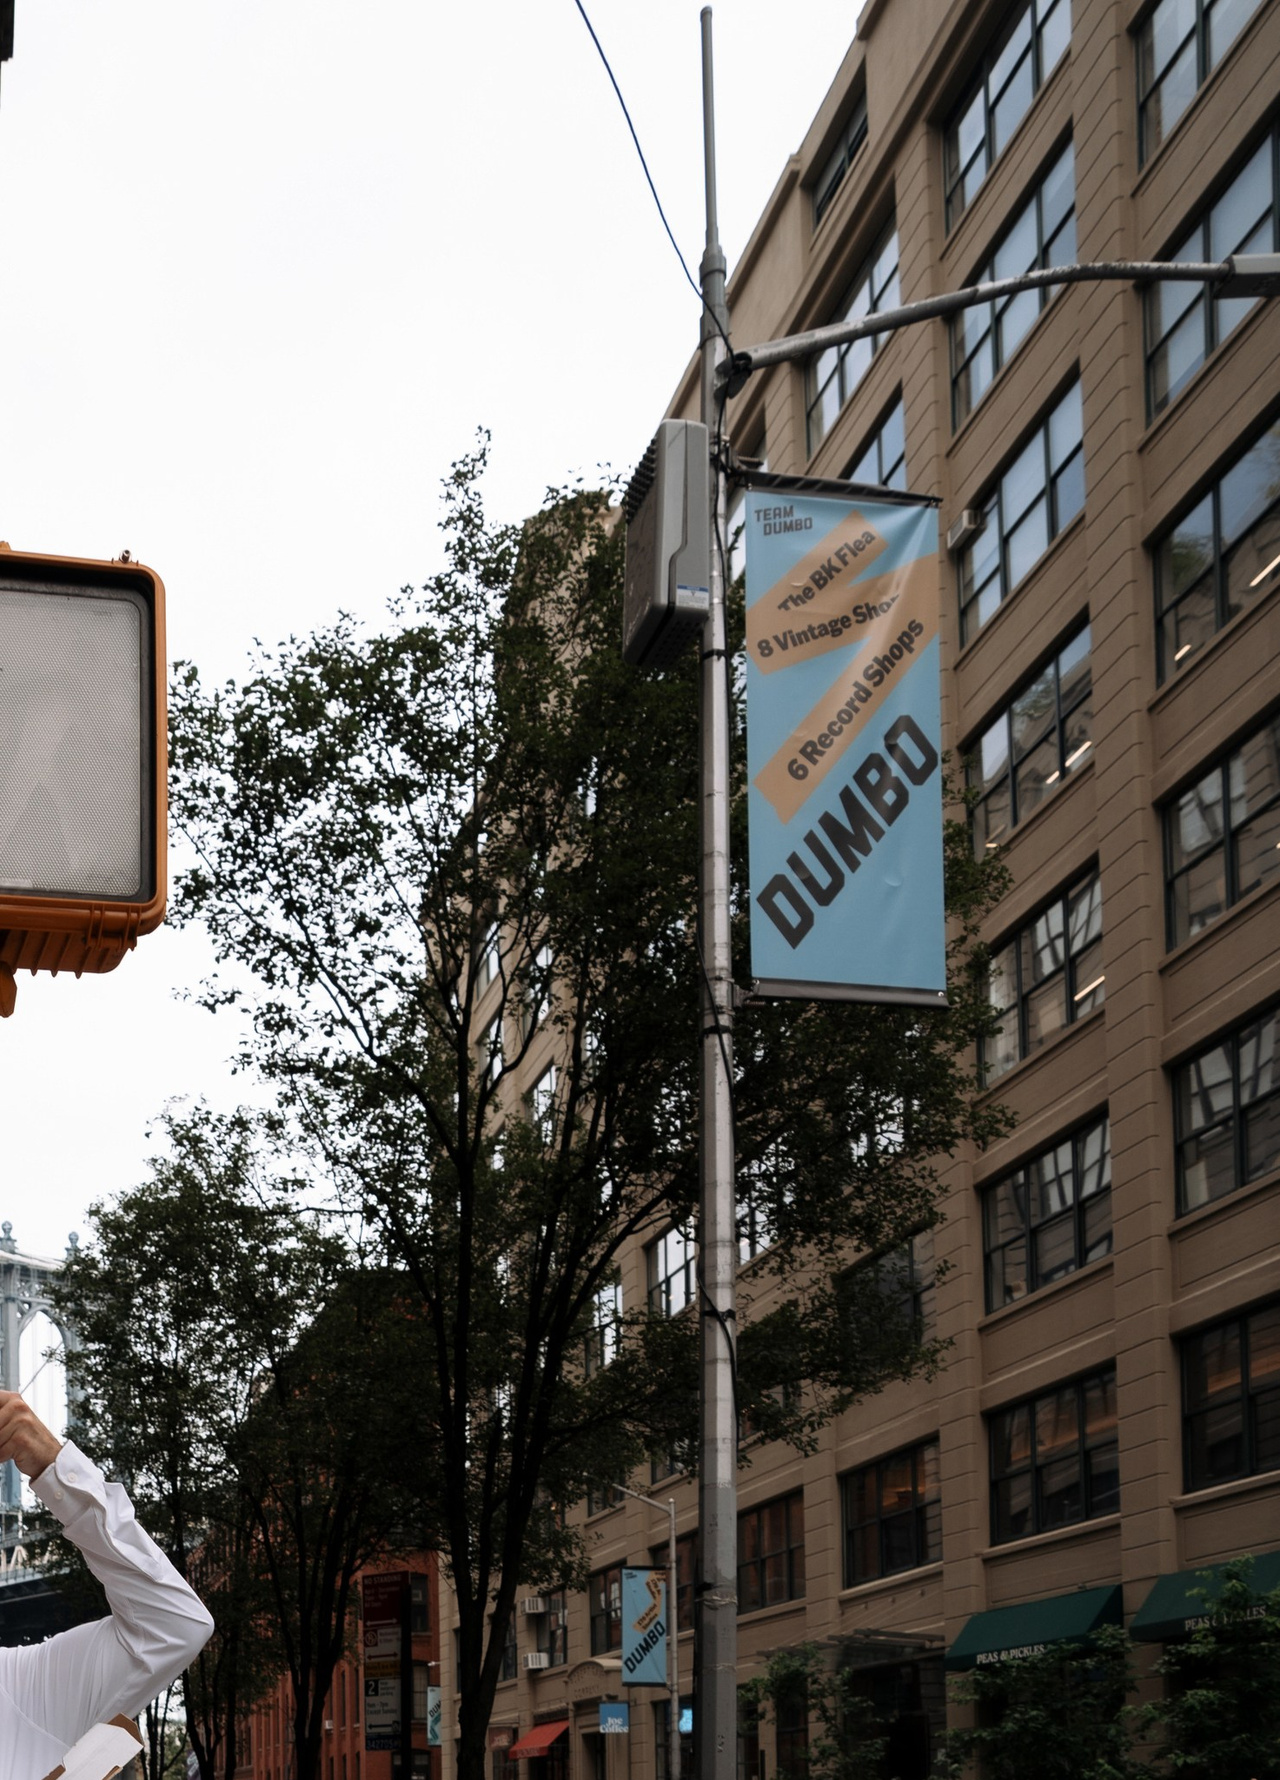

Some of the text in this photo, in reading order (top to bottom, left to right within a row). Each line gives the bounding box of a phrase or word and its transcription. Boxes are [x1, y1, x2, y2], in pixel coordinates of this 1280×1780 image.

[754, 505, 794, 523] TEAM
[763, 516, 813, 537] DUMBO
[809, 557, 842, 590] BK
[834, 531, 876, 567] Flea
[757, 638, 774, 659] 8
[773, 612, 852, 652] Vintage
[787, 617, 925, 782] 6 Record Shops
[756, 714, 939, 950] DUMBO
[623, 1620, 666, 1673] DUMBO
[976, 1651, 999, 1665] PEAS
[1009, 1644, 1045, 1660] PICKLES
[368, 1680, 375, 1695] 2
